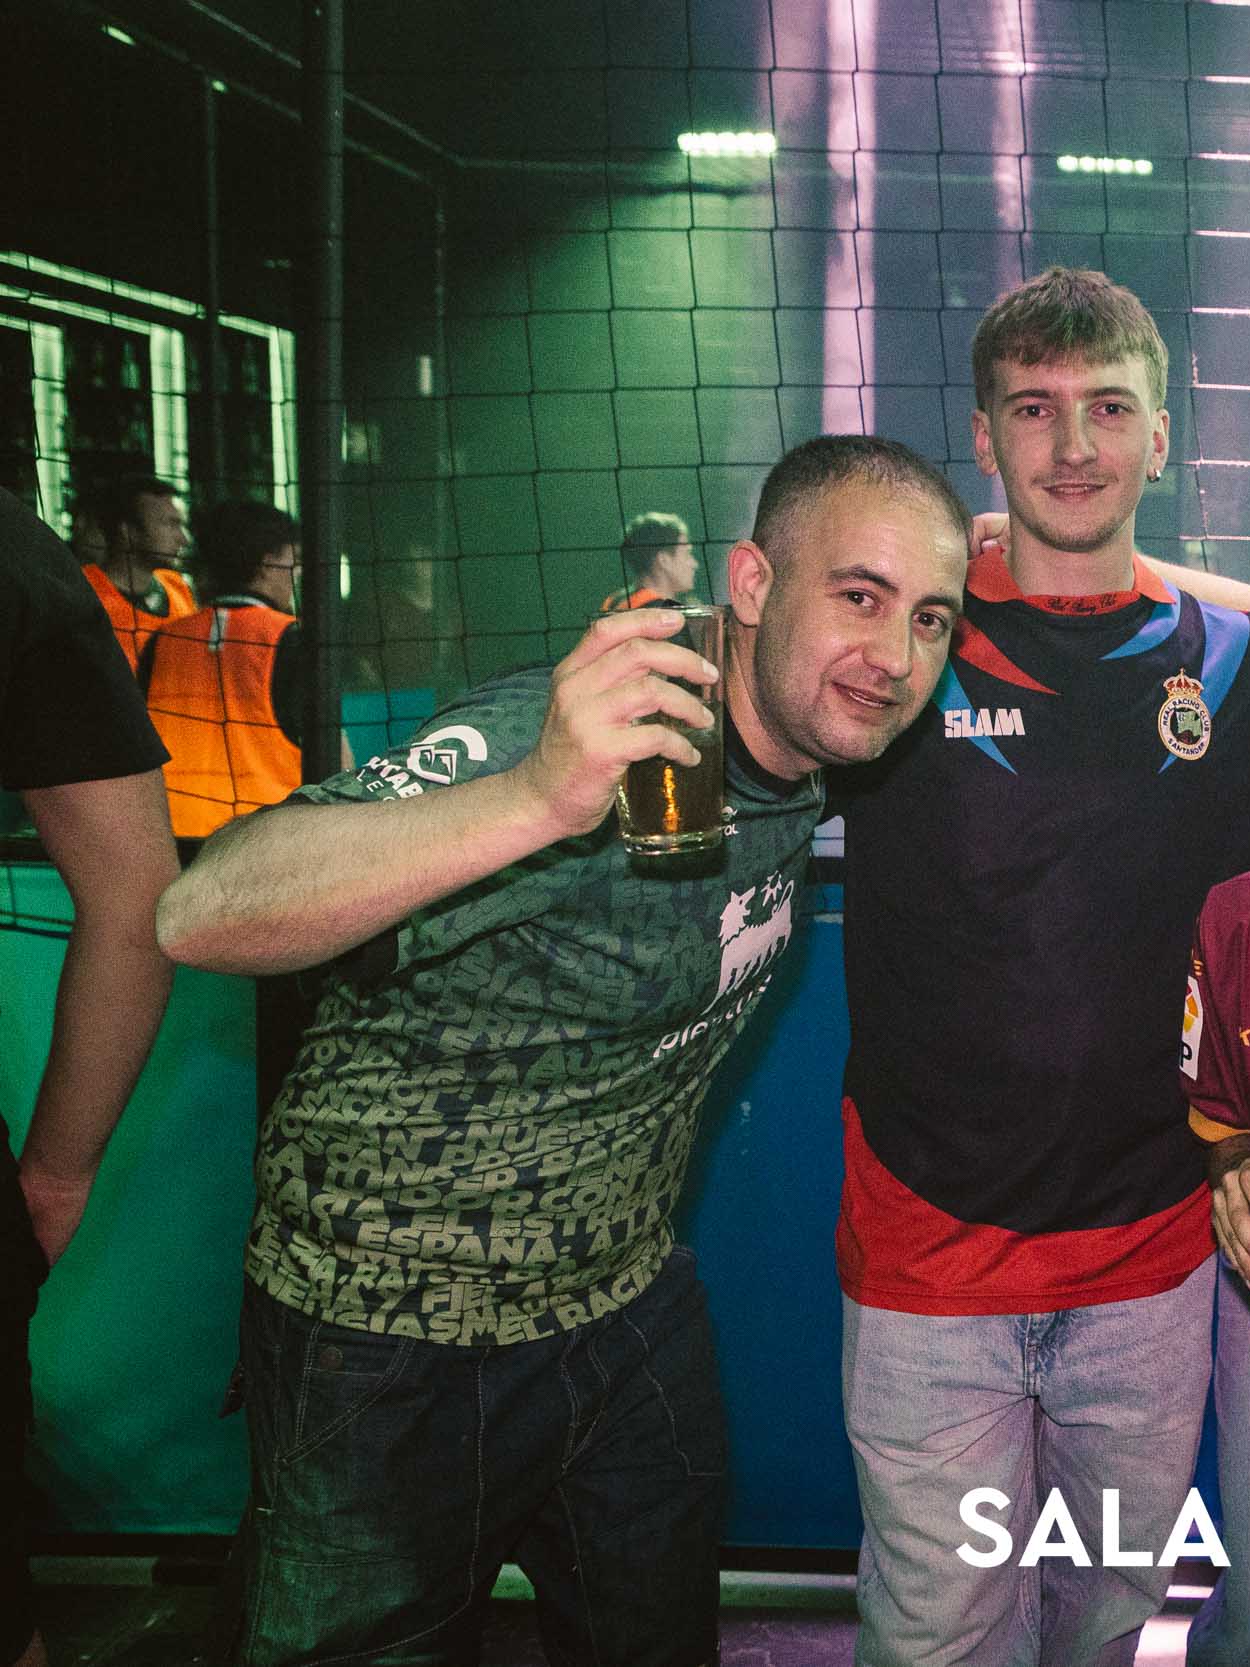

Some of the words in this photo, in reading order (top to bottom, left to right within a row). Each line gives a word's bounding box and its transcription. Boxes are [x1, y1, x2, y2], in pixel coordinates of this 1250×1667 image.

[944, 708, 1026, 738] SLAM
[1172, 698, 1200, 710] RACING
[1200, 710, 1210, 732] CLUB
[1168, 738, 1205, 755] SANTANDER
